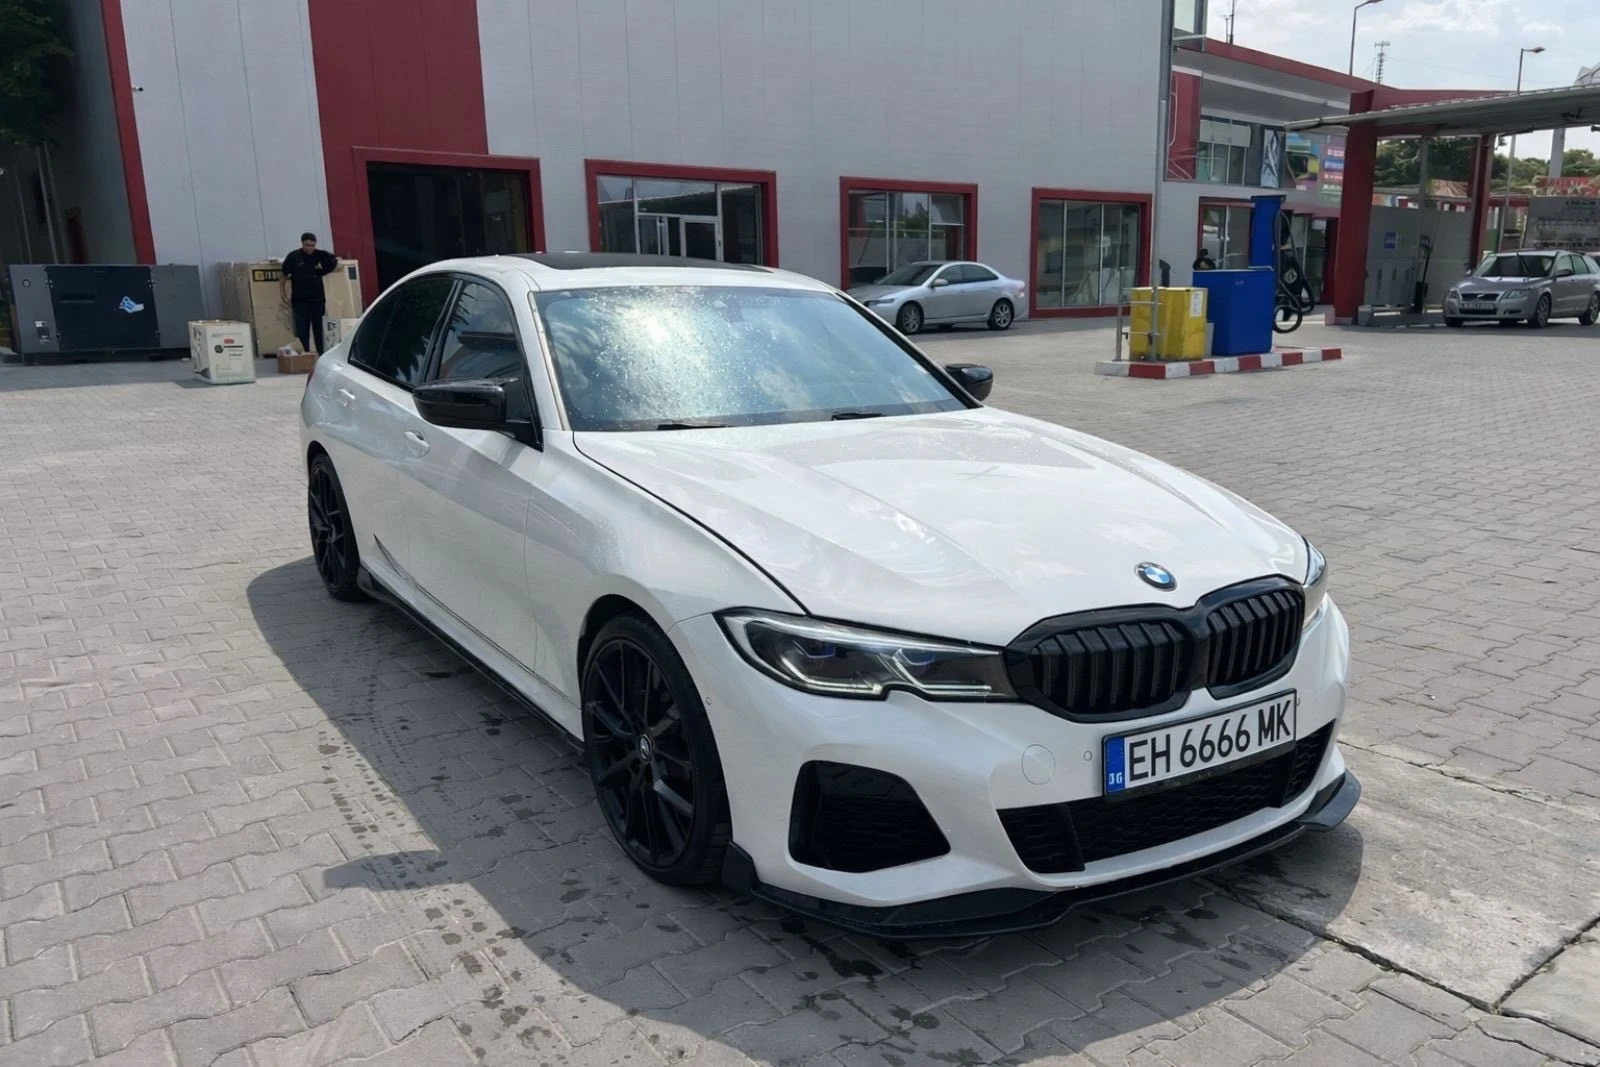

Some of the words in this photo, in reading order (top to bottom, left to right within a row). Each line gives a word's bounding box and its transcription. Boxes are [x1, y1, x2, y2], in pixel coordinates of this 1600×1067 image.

[1129, 734, 1170, 782] EH
[1180, 714, 1250, 768] 6666
[1258, 700, 1291, 746] MK
